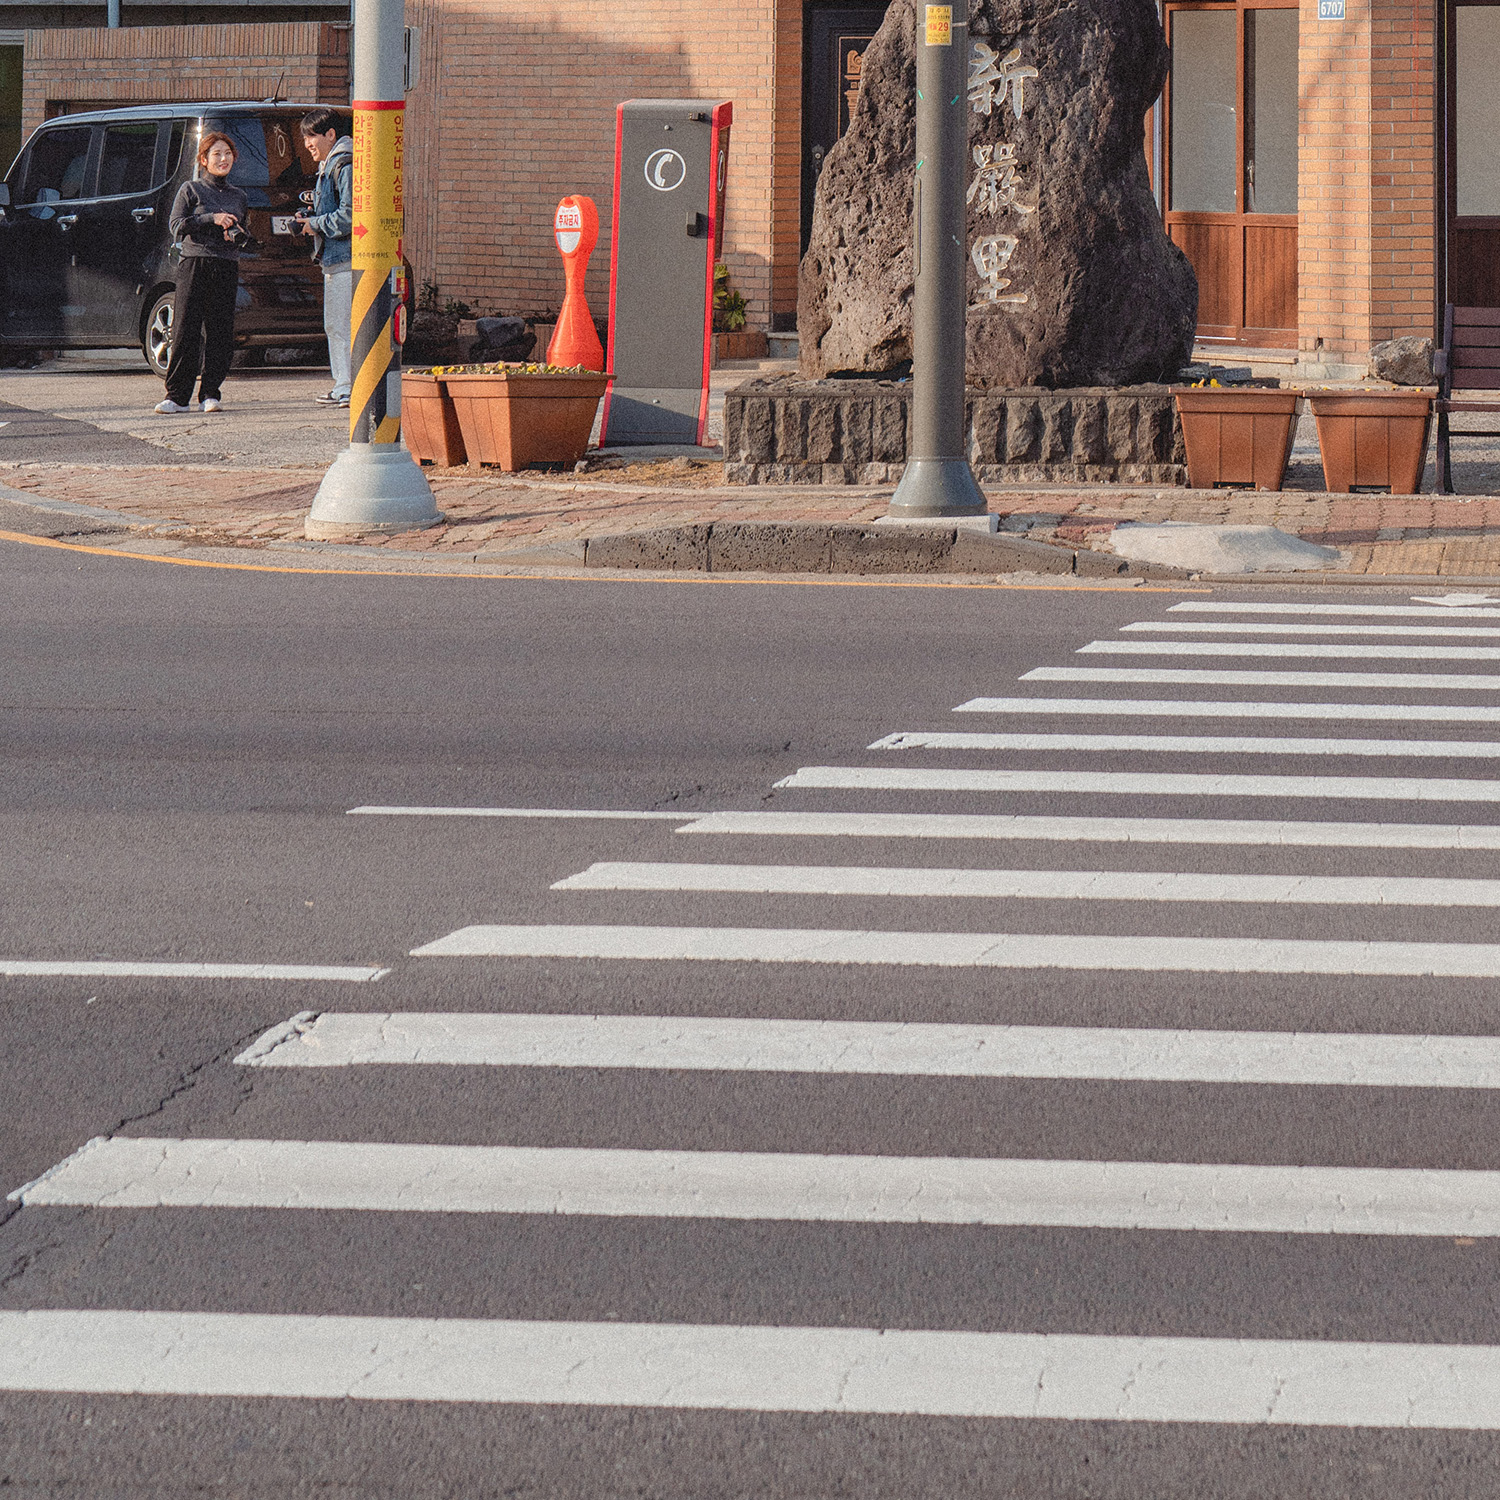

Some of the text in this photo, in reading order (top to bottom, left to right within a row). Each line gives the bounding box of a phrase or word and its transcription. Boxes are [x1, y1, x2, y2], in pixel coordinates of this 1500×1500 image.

[1321, 1, 1343, 16] 6707
[938, 22, 949, 31] 29
[354, 115, 365, 212] 안전비상벨
